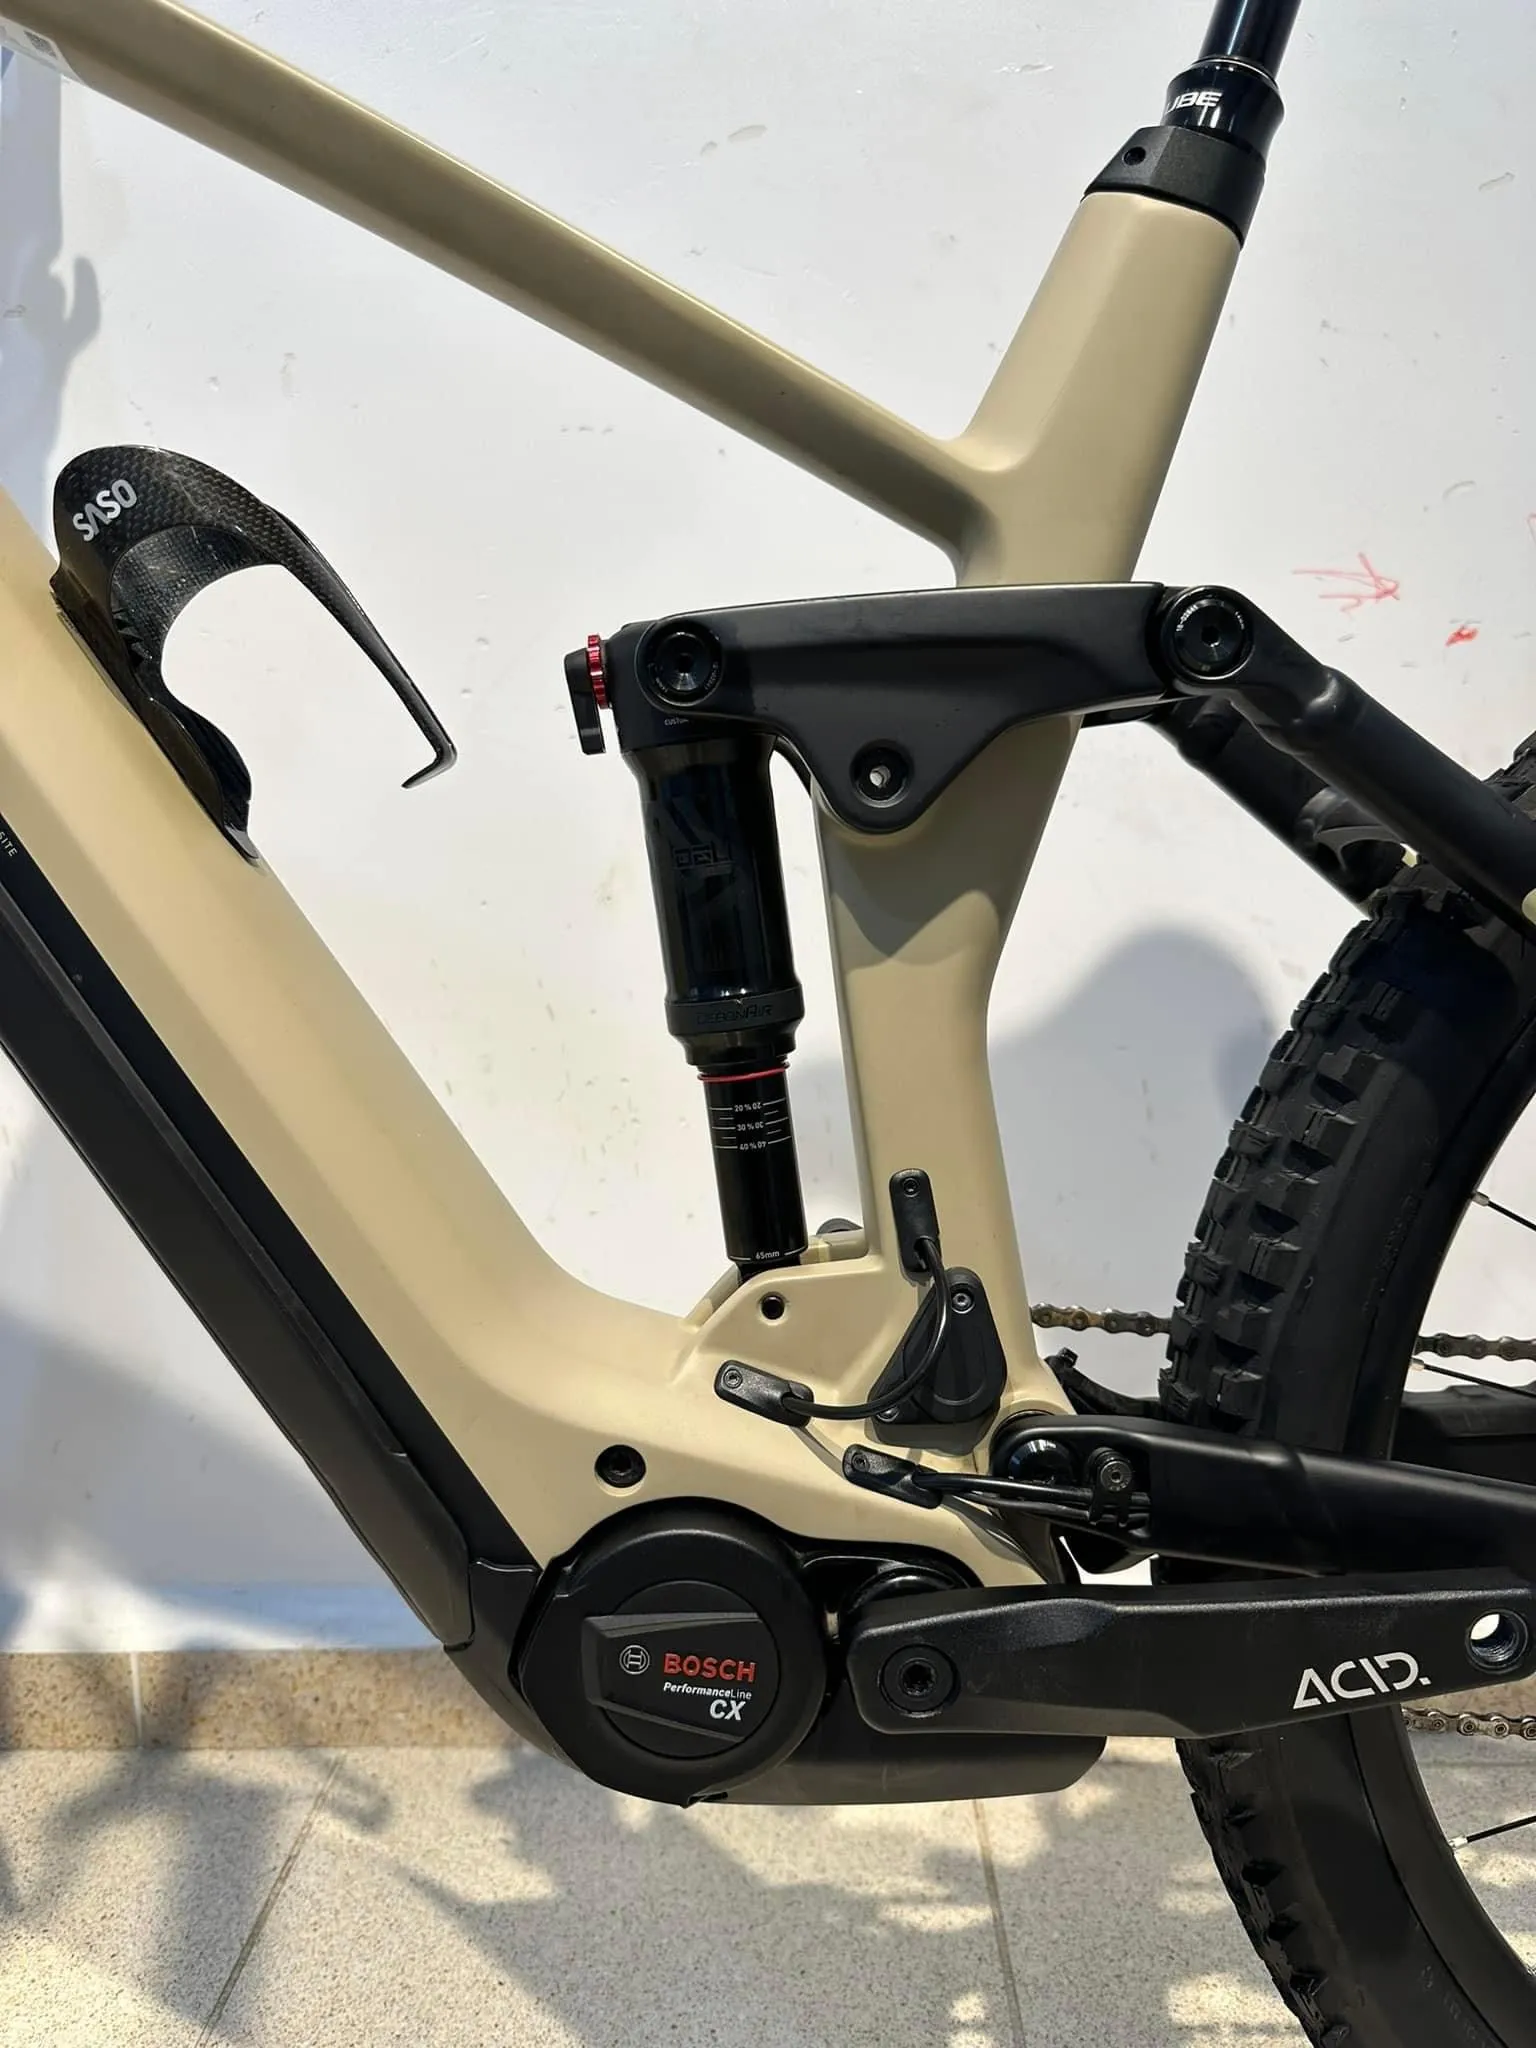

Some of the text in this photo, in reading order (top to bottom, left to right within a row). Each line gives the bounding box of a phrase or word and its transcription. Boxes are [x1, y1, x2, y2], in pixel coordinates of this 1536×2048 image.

[73, 480, 137, 541] SASO
[664, 1653, 756, 1682] BOSCH
[709, 1699, 746, 1720] CX
